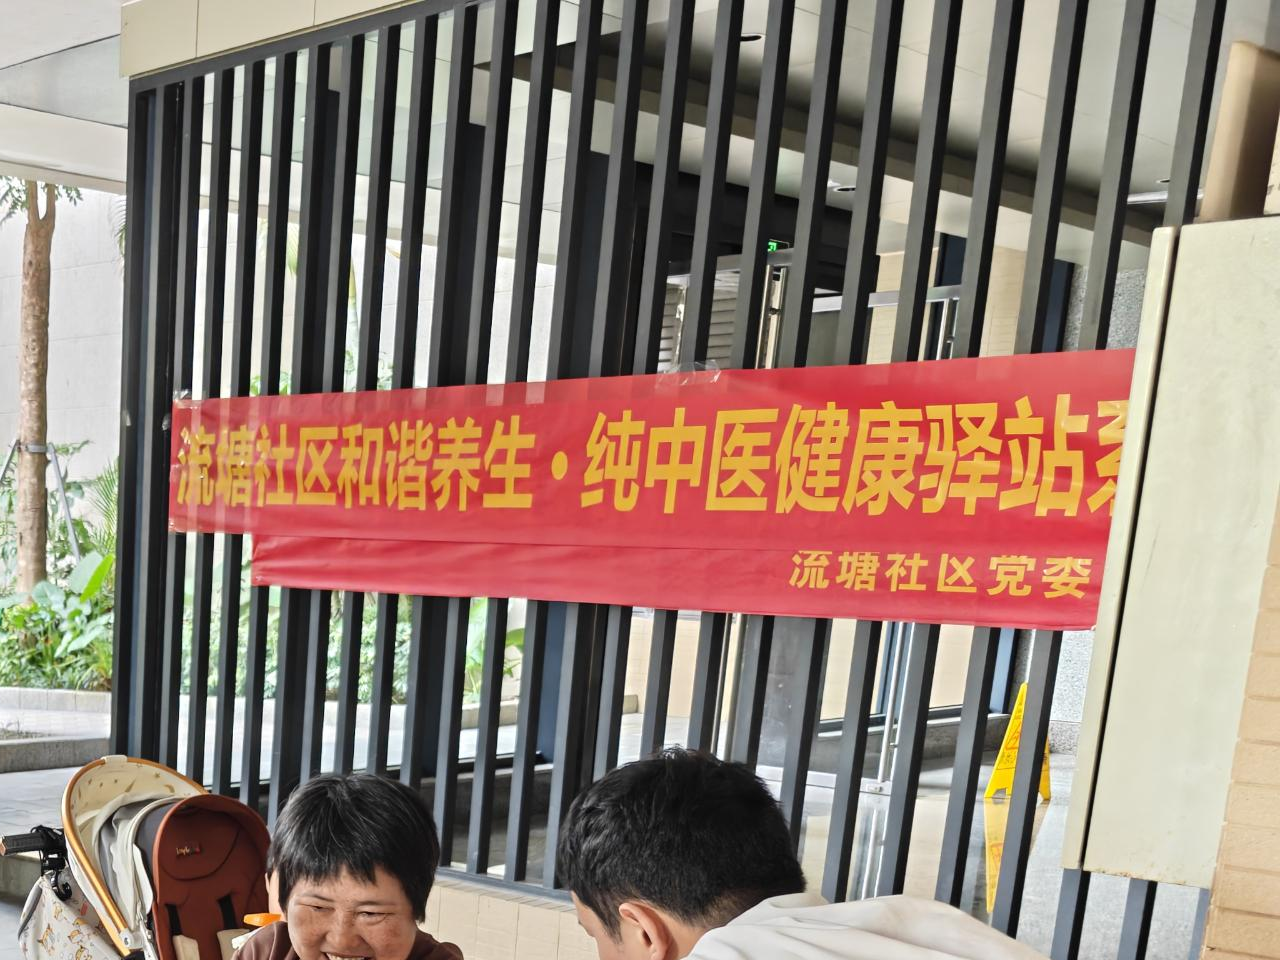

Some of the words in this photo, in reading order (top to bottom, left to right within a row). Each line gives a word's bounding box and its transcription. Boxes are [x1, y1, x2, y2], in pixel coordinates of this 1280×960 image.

[789, 550, 1093, 599] 流塘社区党委
